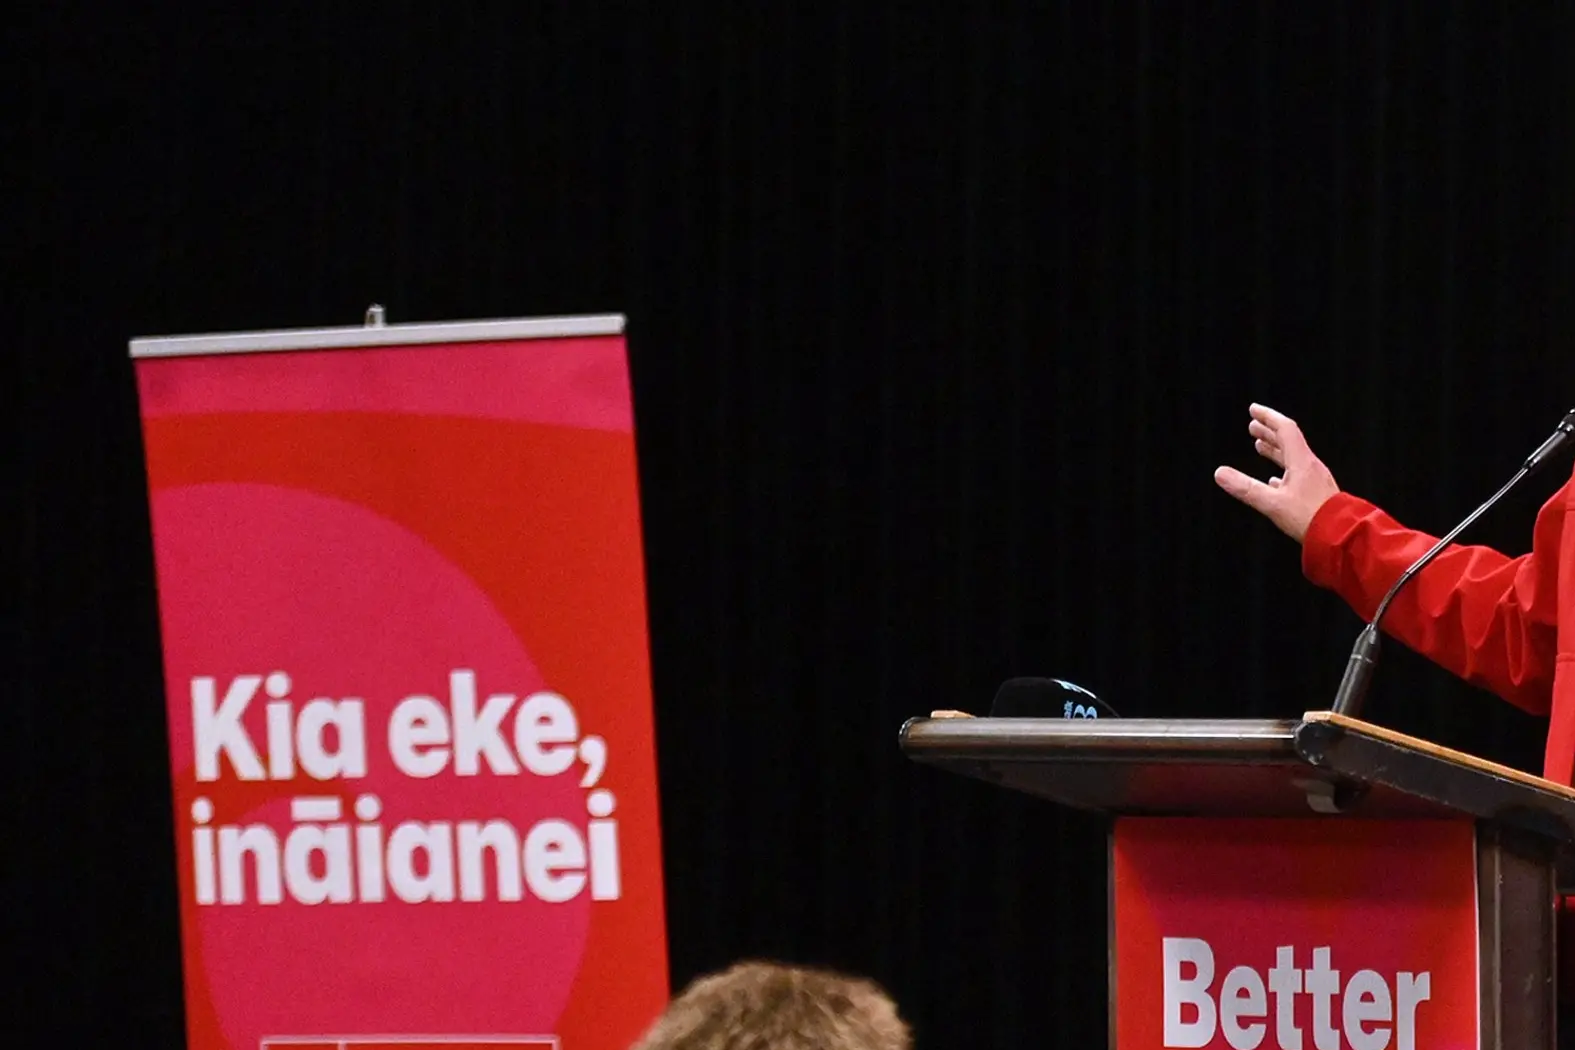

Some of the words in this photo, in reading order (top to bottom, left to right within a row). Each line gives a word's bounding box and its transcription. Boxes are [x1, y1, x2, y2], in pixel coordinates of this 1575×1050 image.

[190, 672, 367, 782] Kia
[388, 669, 608, 786] eke,
[191, 789, 621, 905] ināianei
